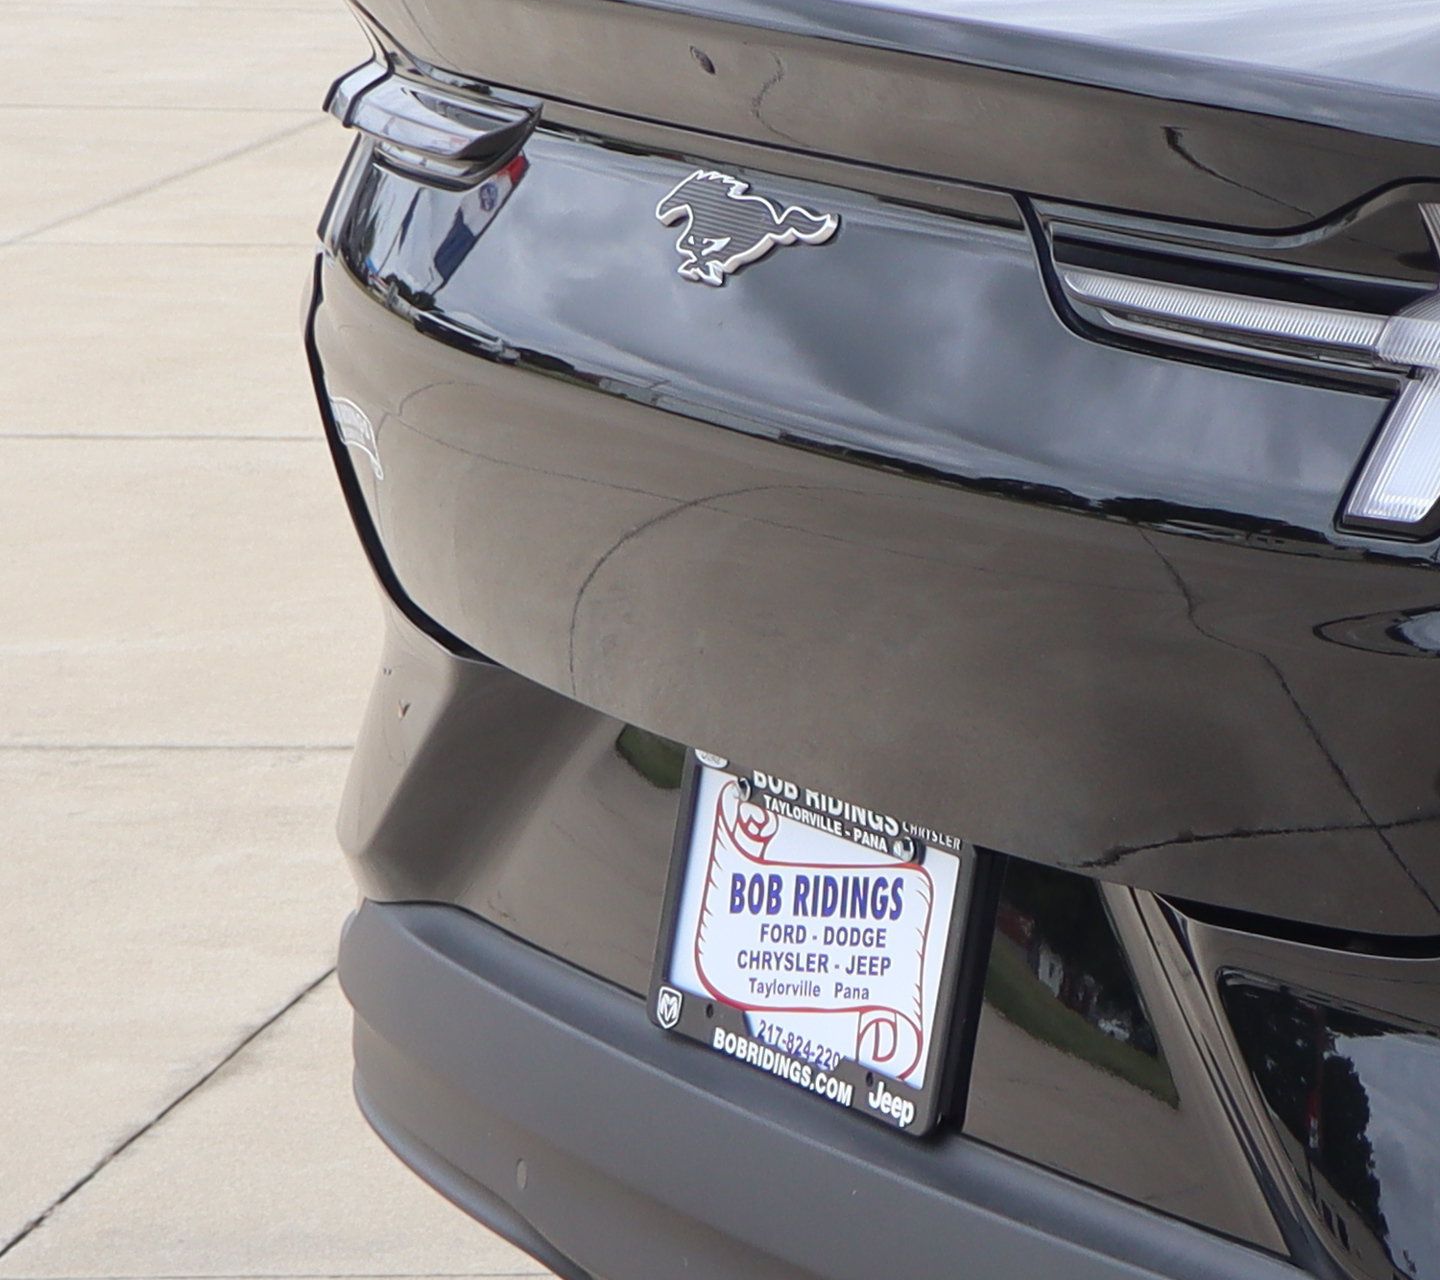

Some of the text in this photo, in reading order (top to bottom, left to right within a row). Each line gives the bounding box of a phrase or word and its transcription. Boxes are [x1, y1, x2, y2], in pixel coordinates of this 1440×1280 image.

[763, 794, 843, 837] TAYLORVILLE
[853, 830, 889, 853] PANA
[729, 872, 905, 921] BOB RIDINGS
[760, 923, 807, 945] FORD
[823, 926, 887, 948] DODGE
[737, 950, 830, 974] CHRYSLER
[845, 955, 892, 977] JEEP
[749, 978, 871, 1001] Taylorville Pana
[757, 1019, 848, 1072] 217-824-220
[713, 1027, 915, 1128] BOBRIDINGS.COM Jeep
